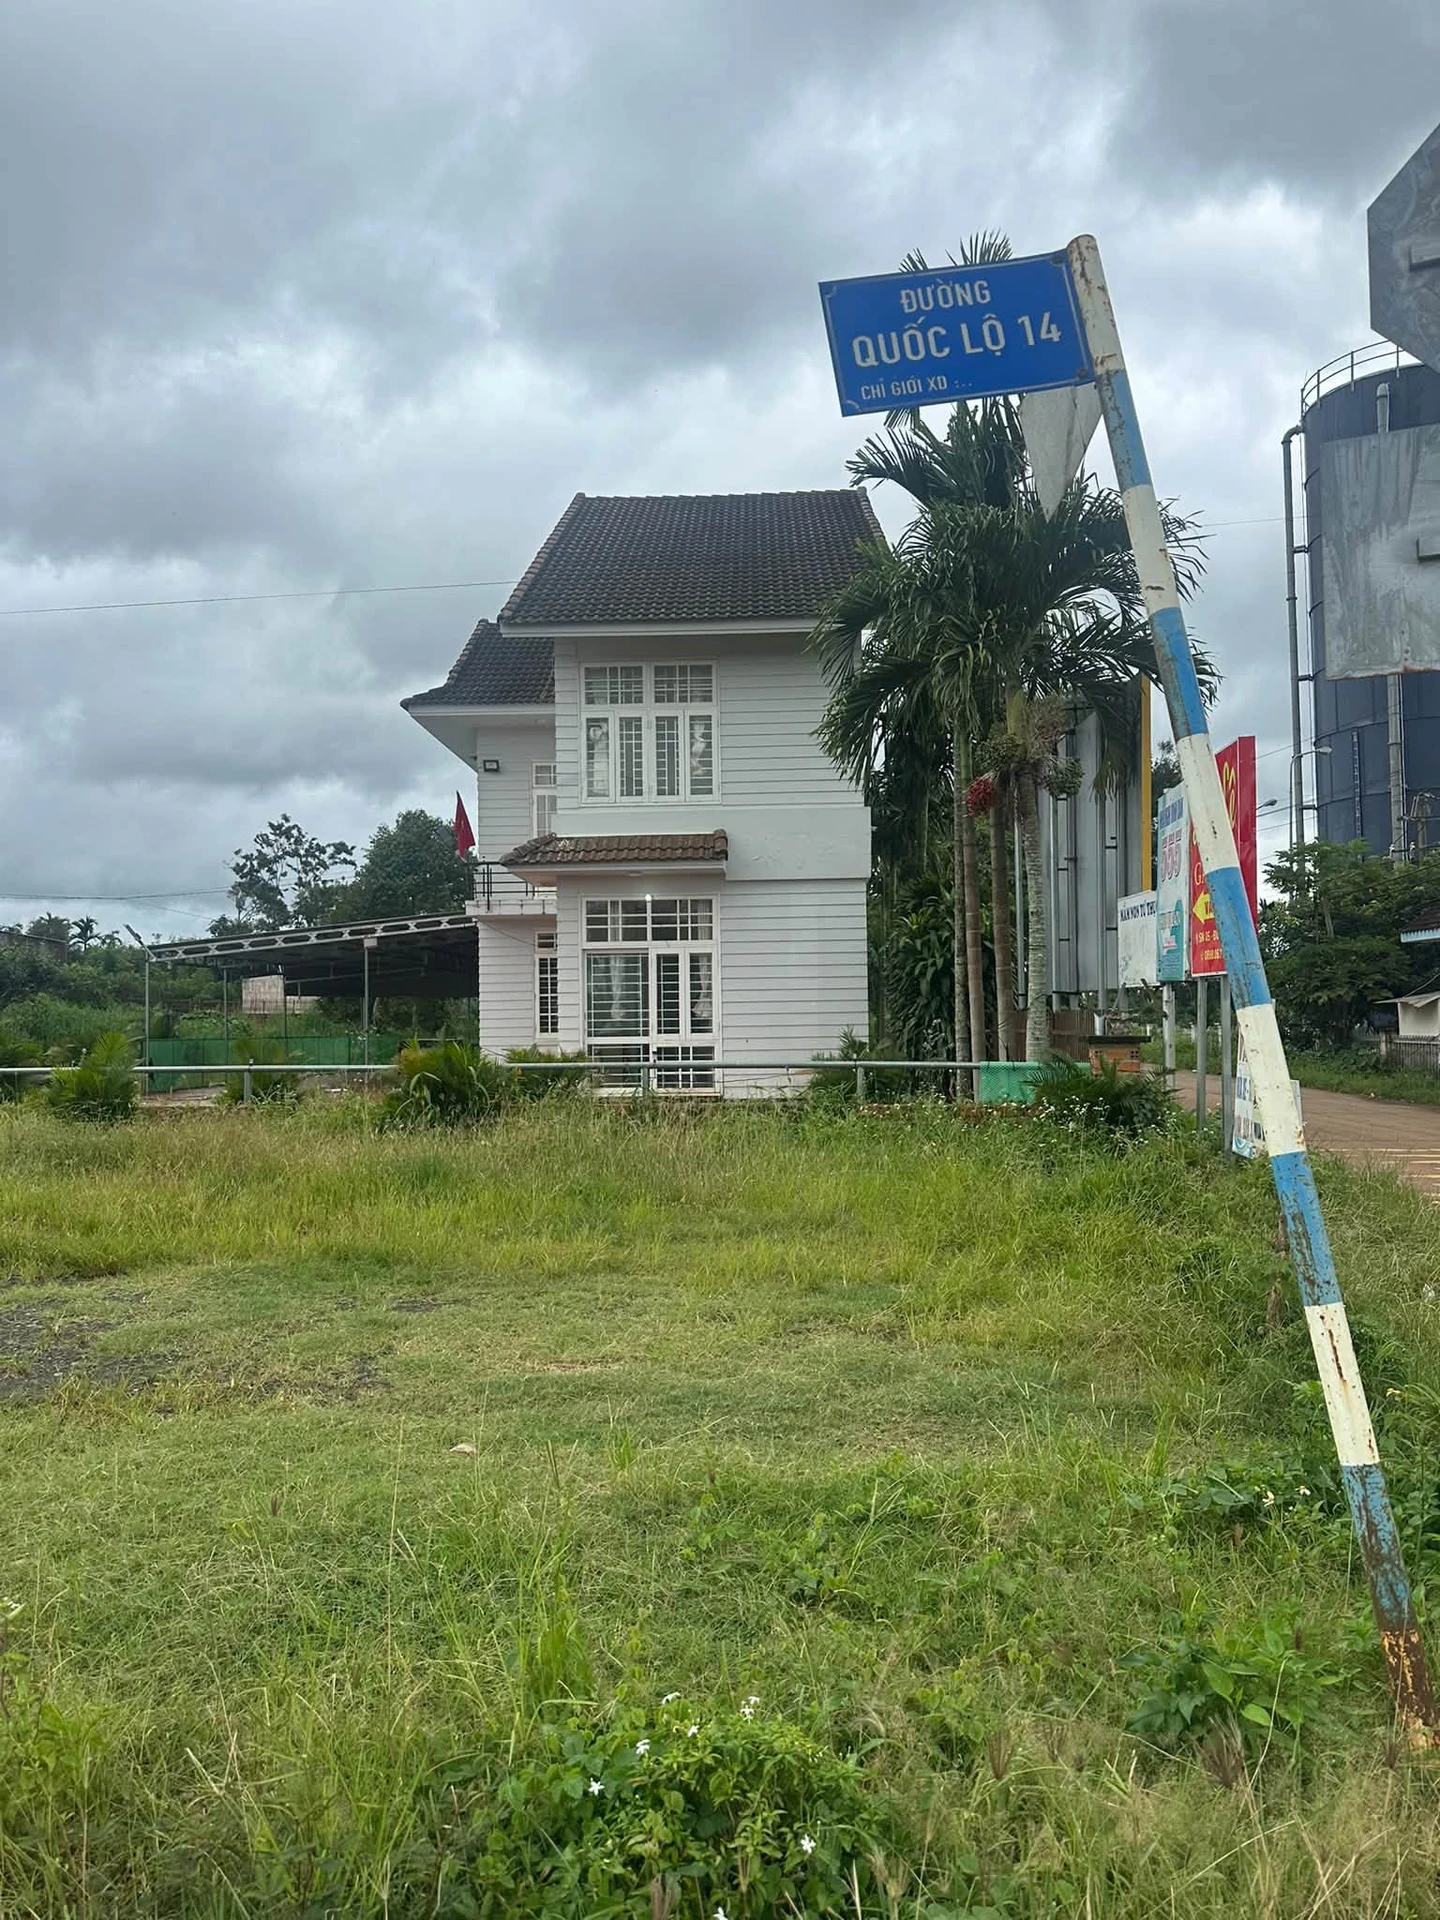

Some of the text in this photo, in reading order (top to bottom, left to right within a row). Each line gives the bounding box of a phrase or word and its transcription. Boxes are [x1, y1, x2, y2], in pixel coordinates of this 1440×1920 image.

[900, 279, 991, 313] ĐƯỜNG
[852, 312, 1061, 368] QUỐC LỘ 14
